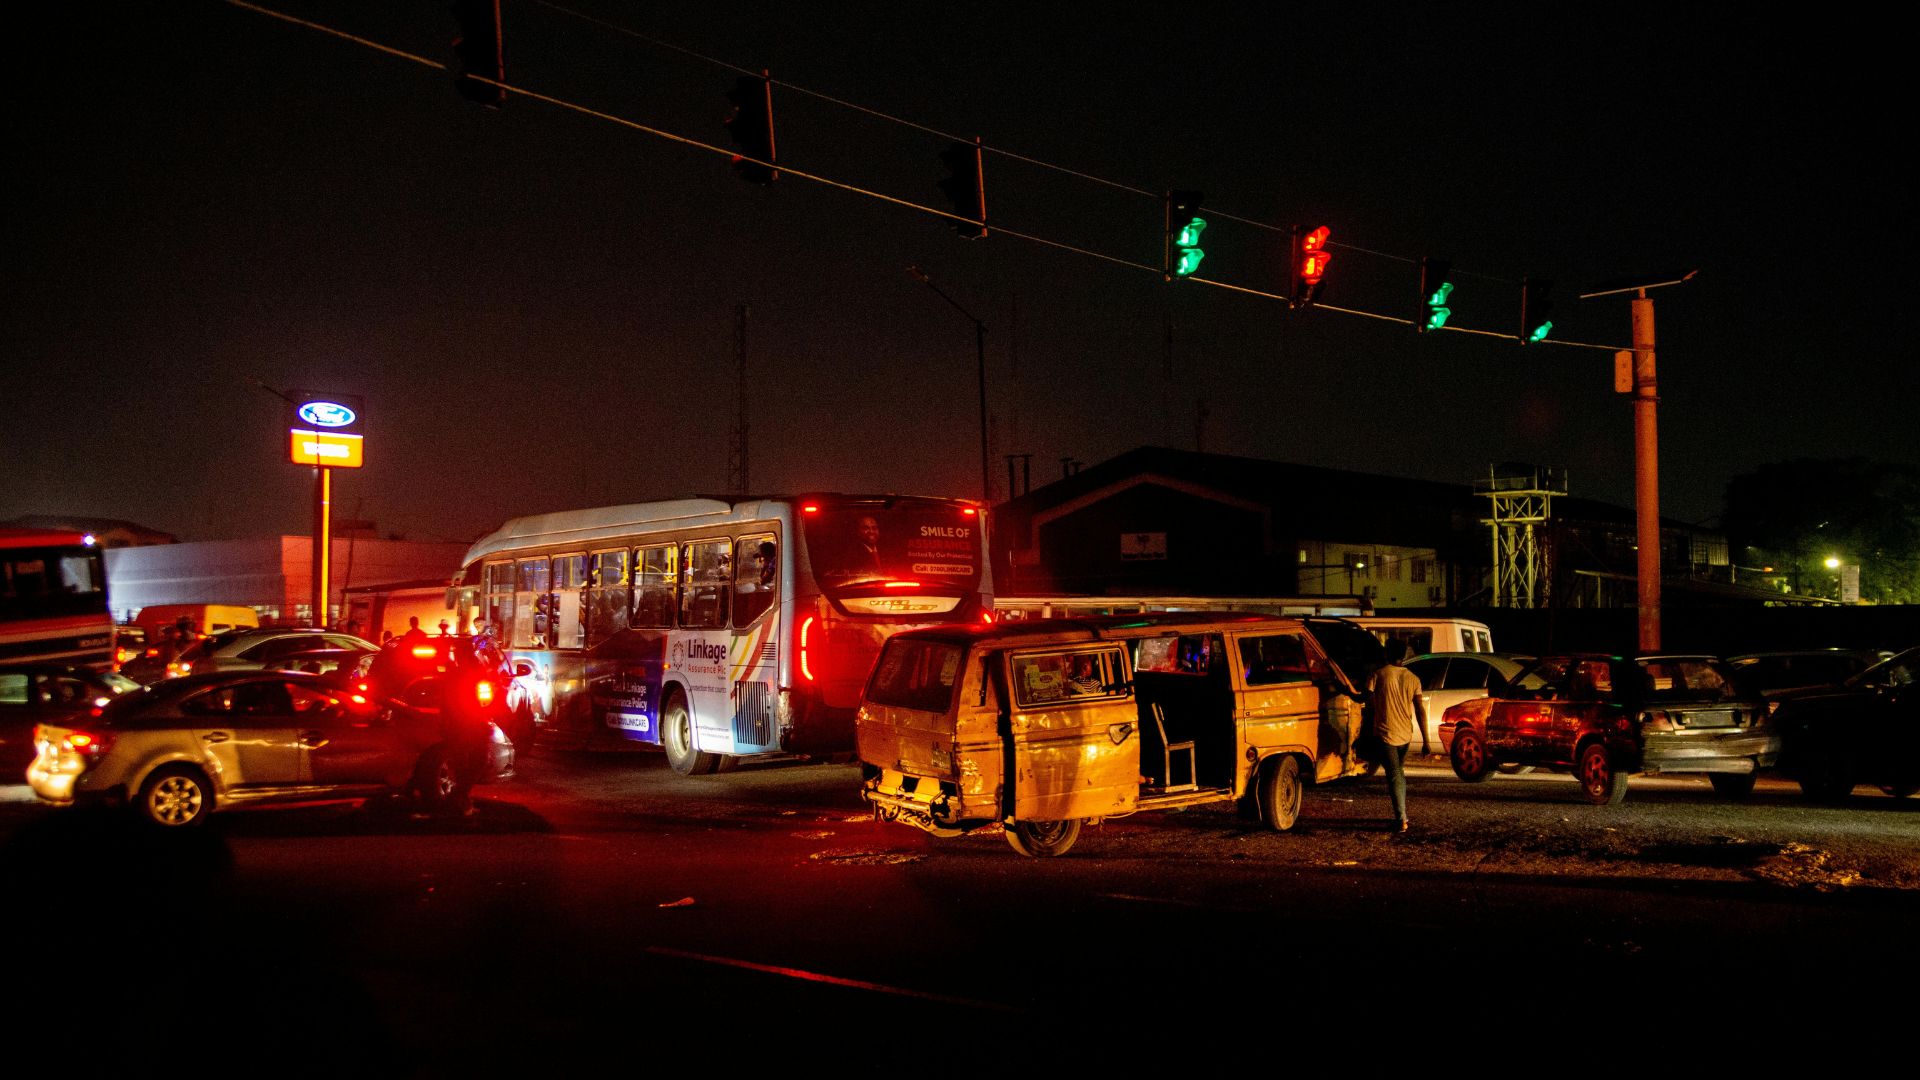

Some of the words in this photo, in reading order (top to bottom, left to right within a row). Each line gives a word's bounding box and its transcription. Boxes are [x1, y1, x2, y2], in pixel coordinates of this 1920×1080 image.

[920, 526, 955, 538] SMILE
[956, 527, 970, 538] OF
[688, 639, 726, 664] Linkage
[687, 664, 716, 674] Assurance
[717, 665, 726, 675] Plc
[632, 696, 647, 711] Policy
